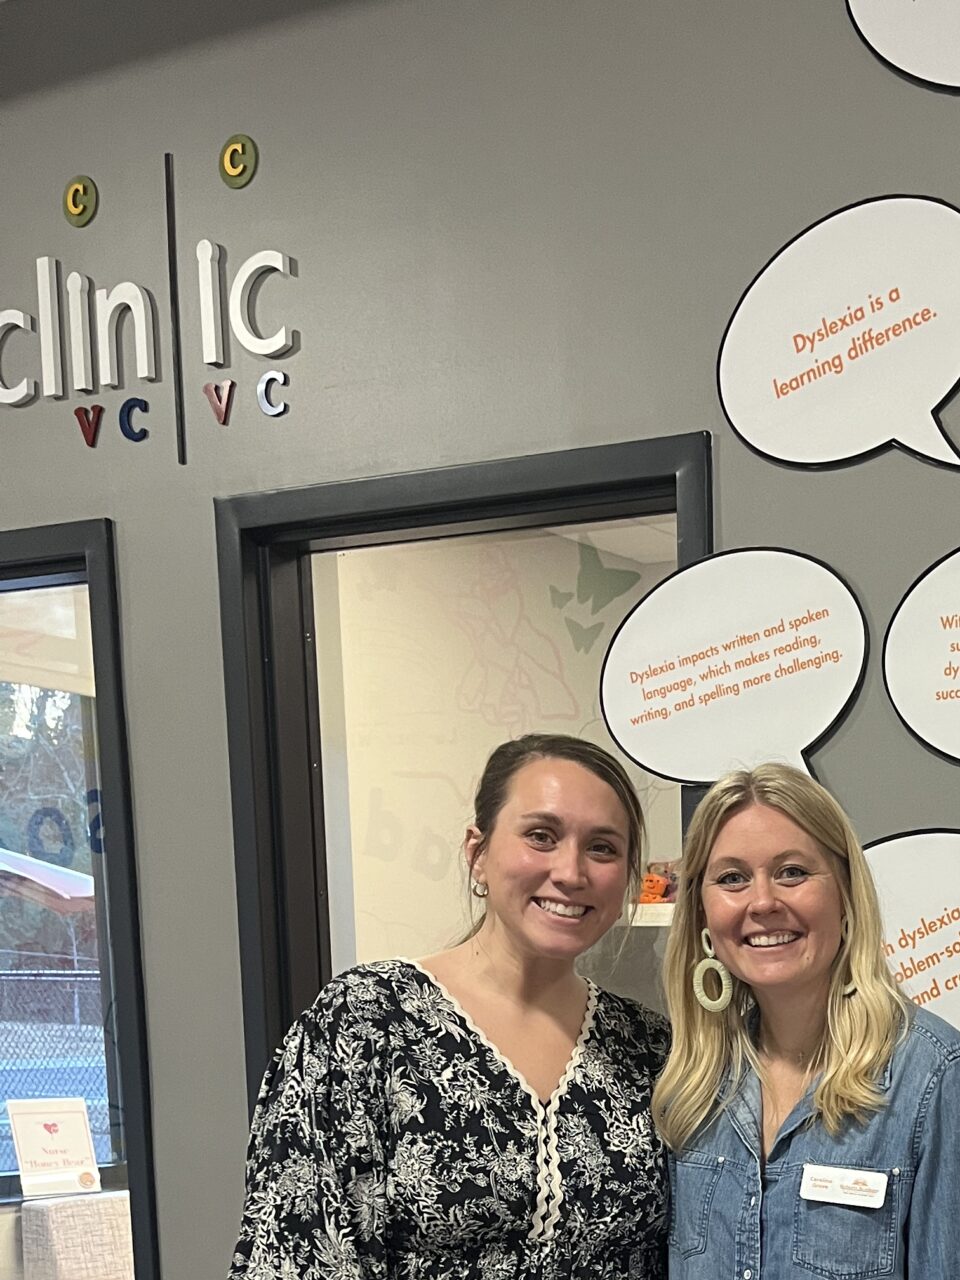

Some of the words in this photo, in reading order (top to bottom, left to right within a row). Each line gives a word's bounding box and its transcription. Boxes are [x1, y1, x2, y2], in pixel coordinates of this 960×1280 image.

[197, 239, 293, 365] ic
[792, 305, 865, 353] Dyslexia
[868, 294, 884, 314] is
[888, 287, 901, 303] a
[772, 353, 844, 399] learning
[847, 306, 937, 361] difference.
[630, 662, 676, 685] Dyslexia
[677, 646, 719, 668] impacts
[722, 630, 760, 652] written
[763, 619, 785, 639] and
[789, 608, 830, 631] spoken
[642, 675, 697, 701] language,
[699, 660, 731, 682] which
[734, 649, 770, 669] makes
[773, 633, 821, 658] reading,
[630, 706, 671, 726] writing,
[674, 693, 695, 712] and
[698, 681, 741, 706] spelling
[743, 671, 771, 689] more
[774, 650, 843, 678] challenging.
